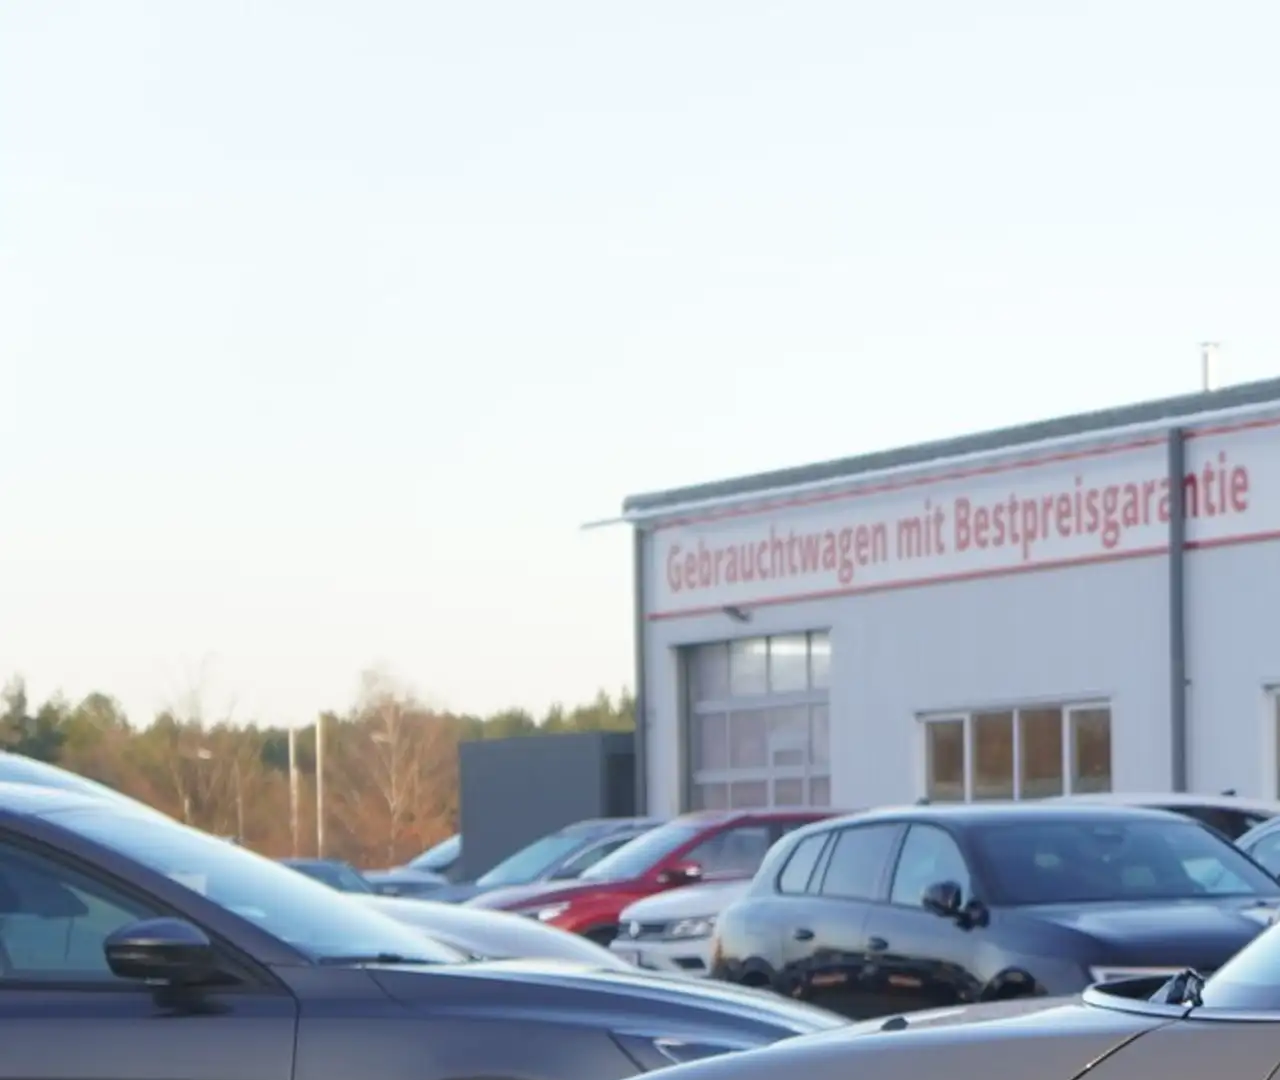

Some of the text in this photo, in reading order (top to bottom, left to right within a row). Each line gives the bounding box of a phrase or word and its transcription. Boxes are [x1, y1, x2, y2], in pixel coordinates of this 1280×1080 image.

[666, 450, 1249, 584] Gebrauchtwagen mit Bestpreisgarantie
